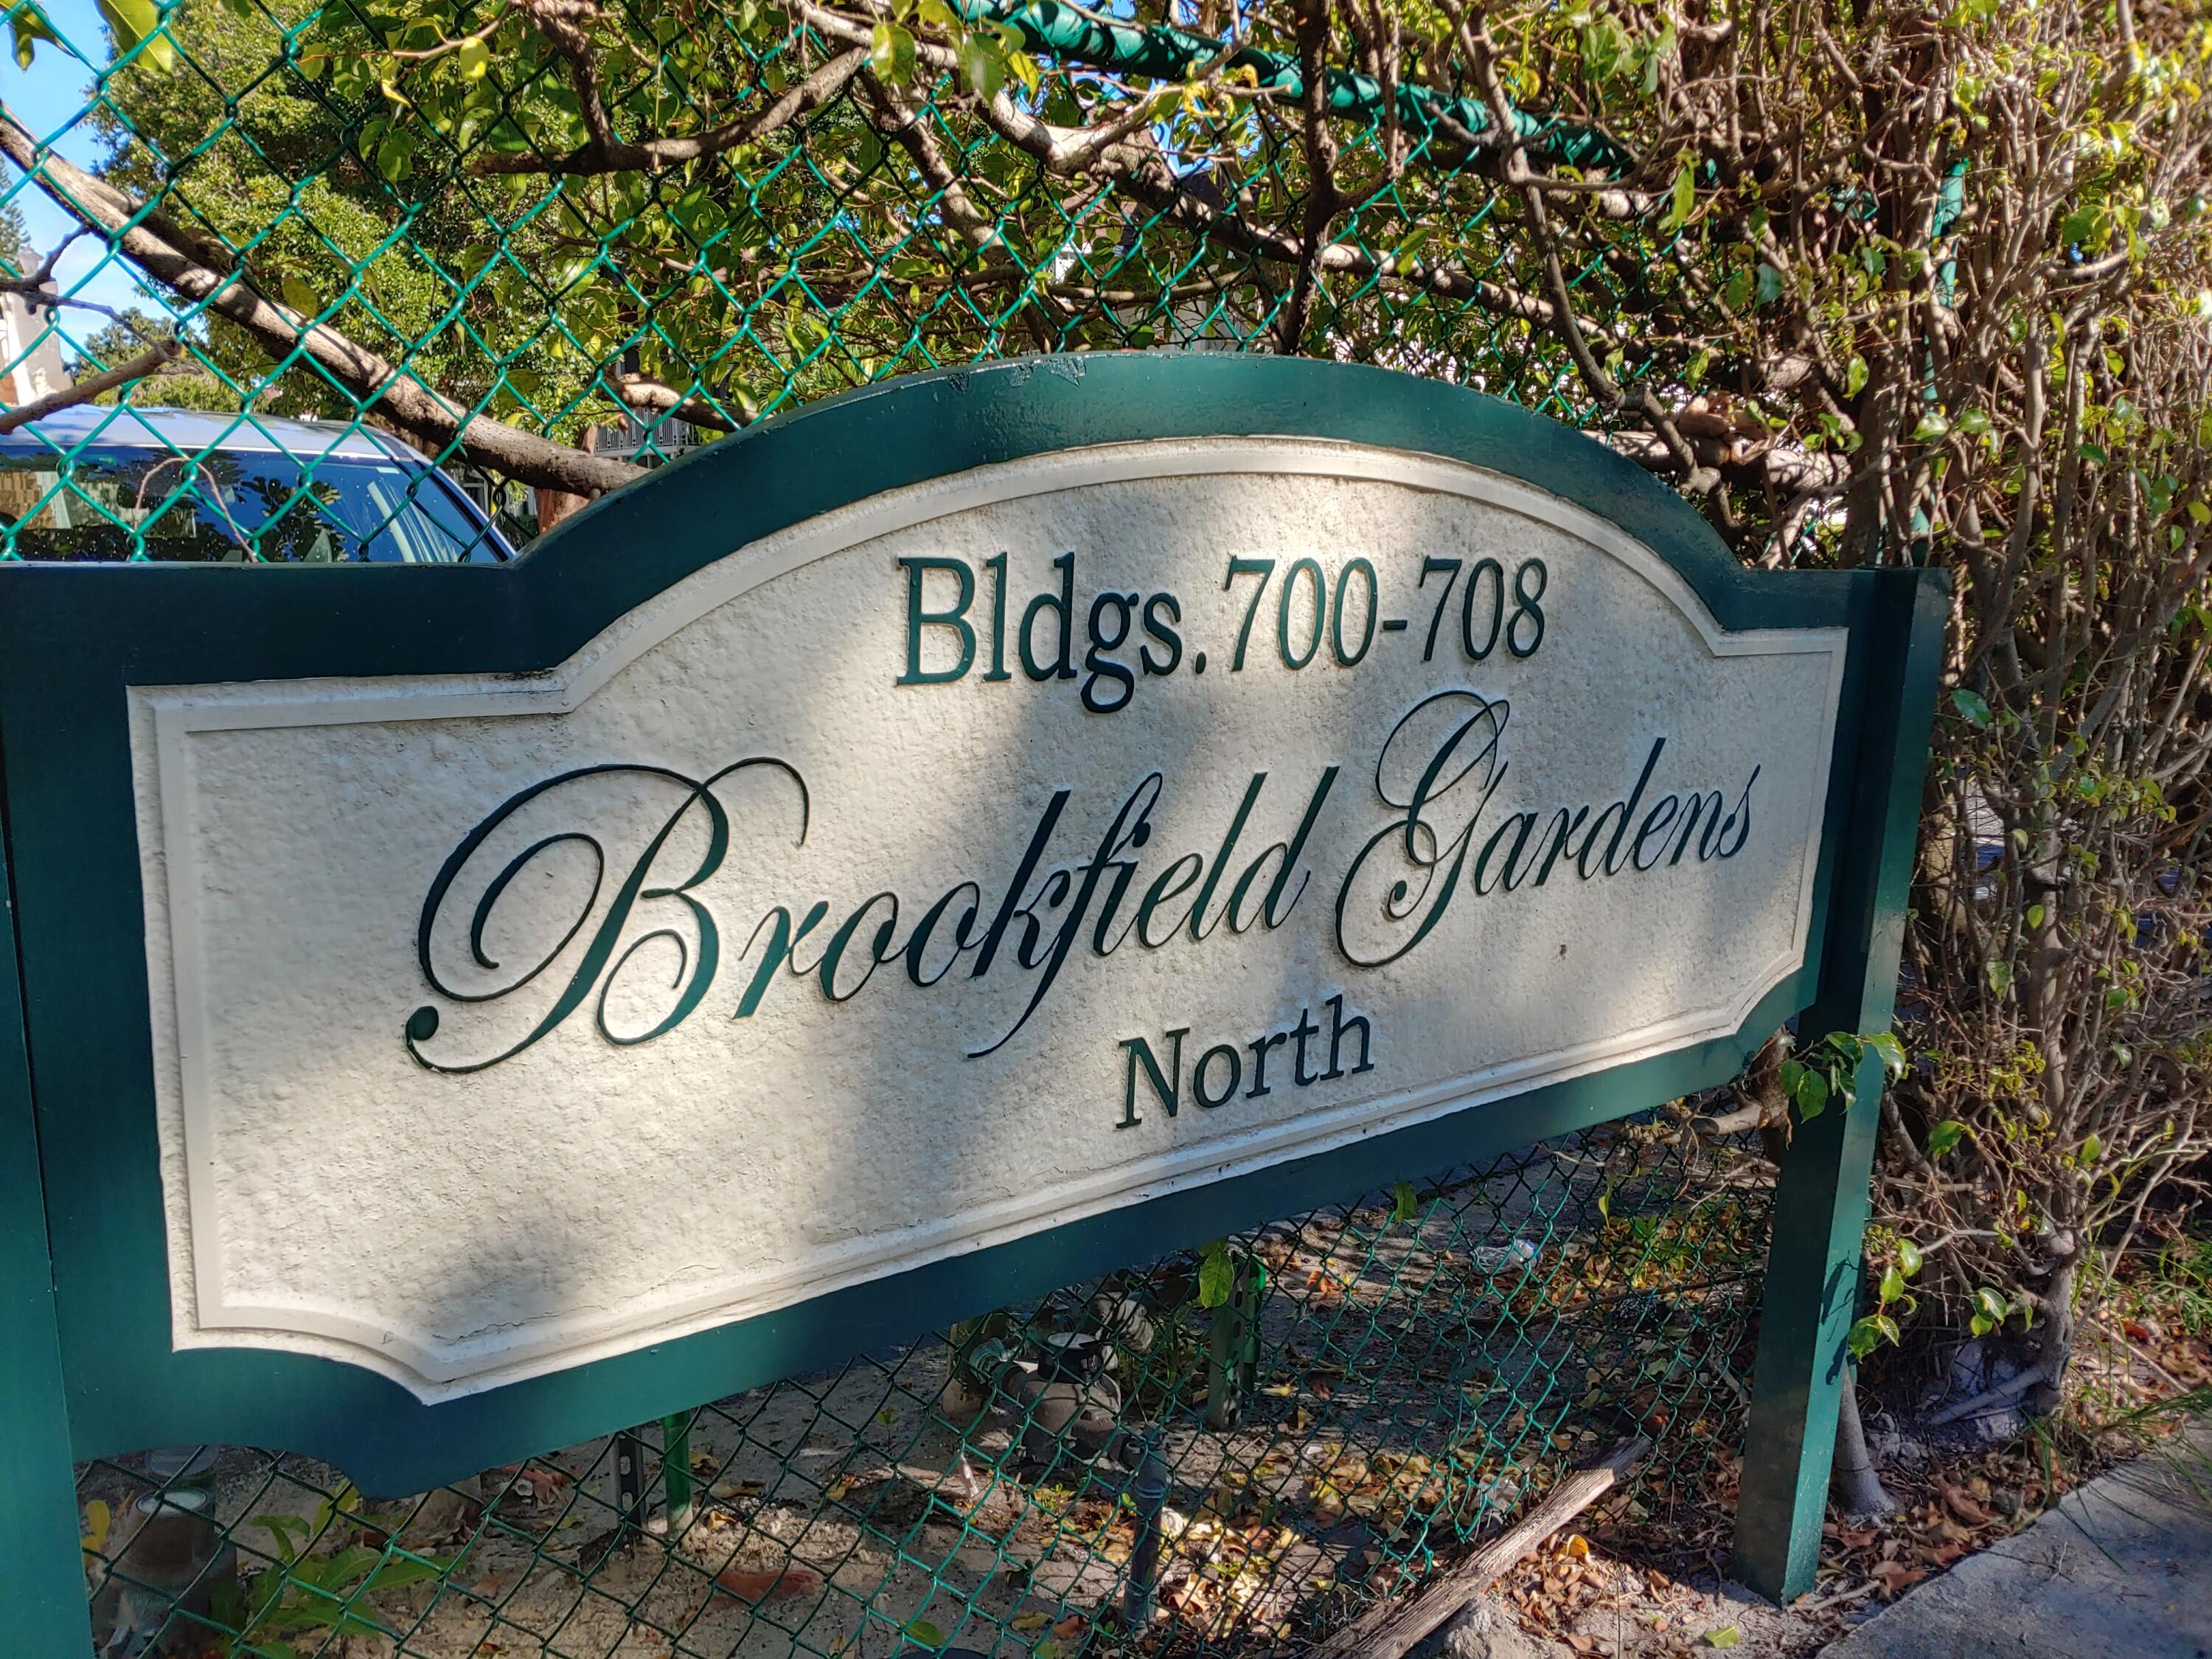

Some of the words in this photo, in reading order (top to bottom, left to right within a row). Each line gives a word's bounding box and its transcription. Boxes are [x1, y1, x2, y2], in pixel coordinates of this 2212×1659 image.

[404, 756, 1340, 1074] Brookfield
[1334, 689, 1761, 968] Gardens
[1114, 992, 1375, 1130] North
